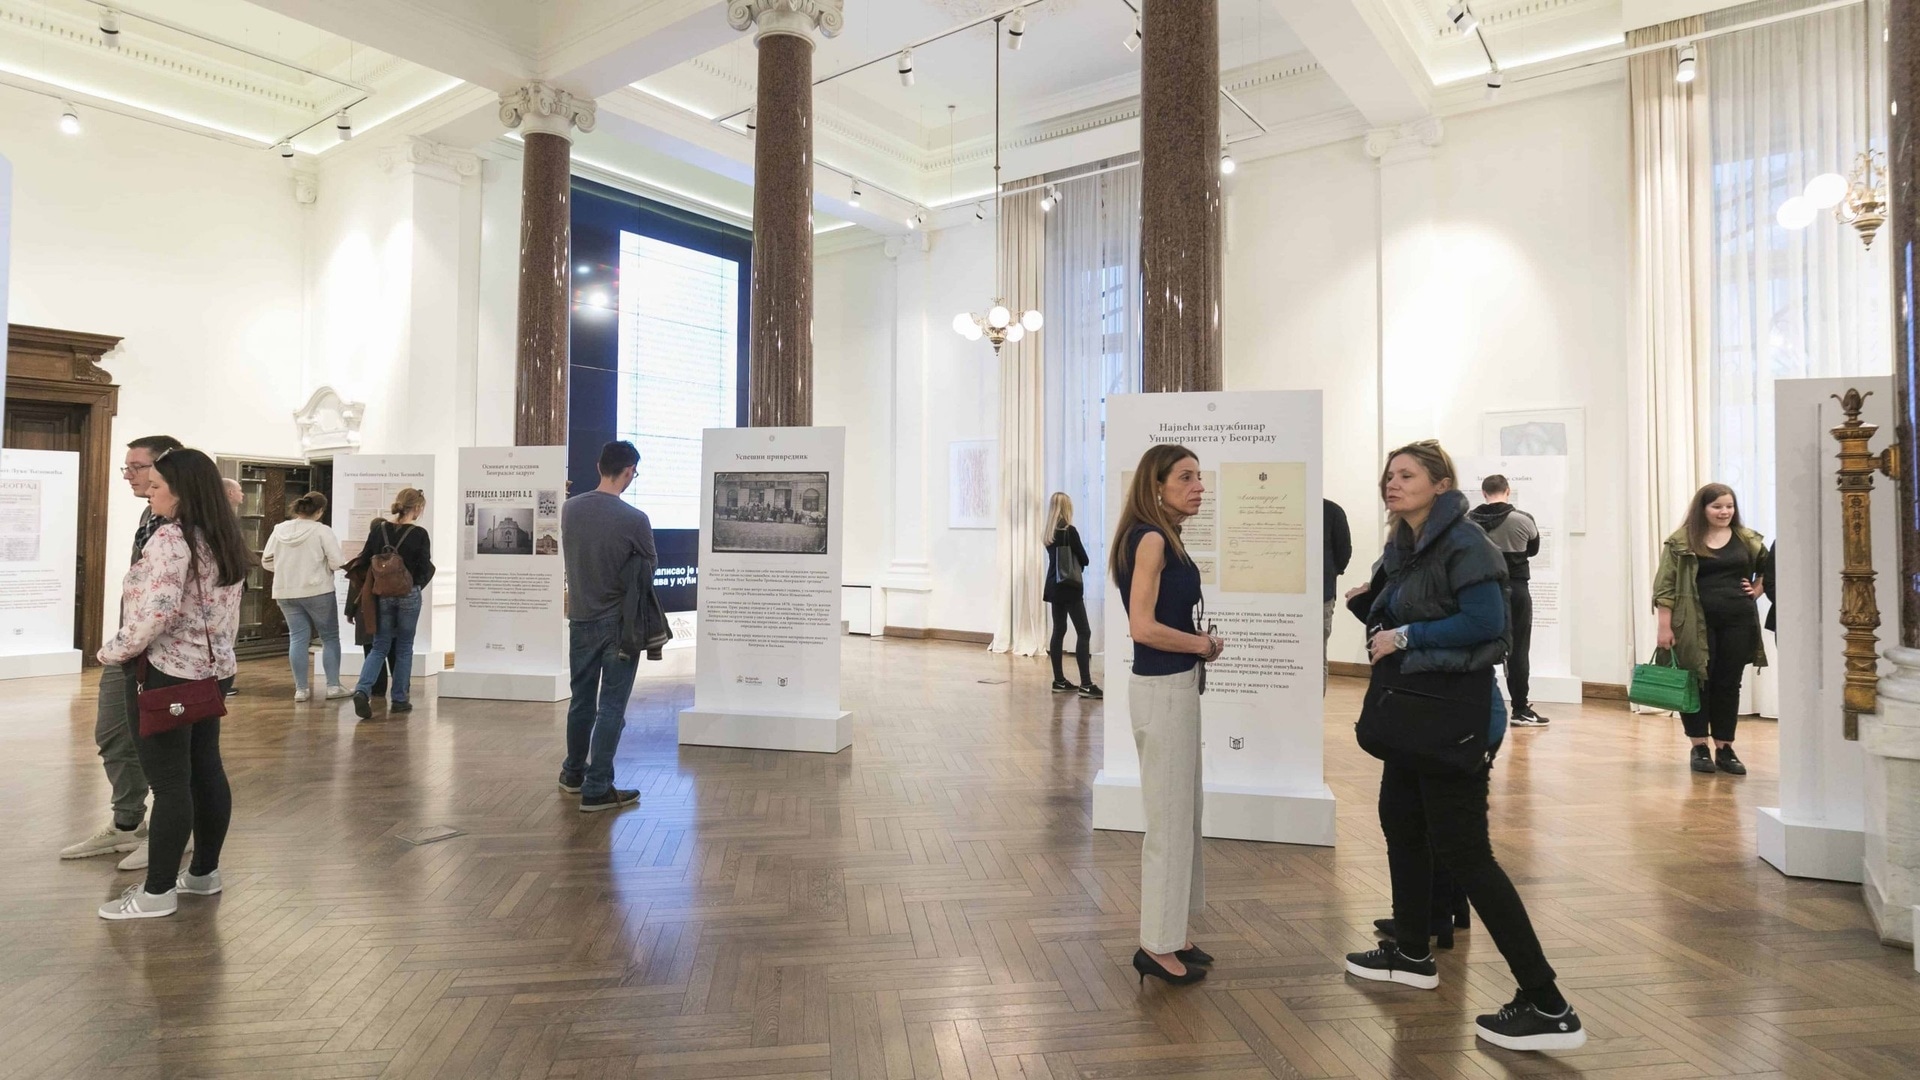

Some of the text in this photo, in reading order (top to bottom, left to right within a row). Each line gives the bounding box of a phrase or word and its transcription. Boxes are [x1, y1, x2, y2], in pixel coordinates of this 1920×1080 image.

[1159, 422, 1265, 433] Највећи задужбинар
[1149, 434, 1276, 444] Универзитета у Београду
[736, 453, 764, 461] Успешни
[466, 490, 498, 498] БЕОГРАДСКА
[500, 490, 521, 498] ЗАДРУГА
